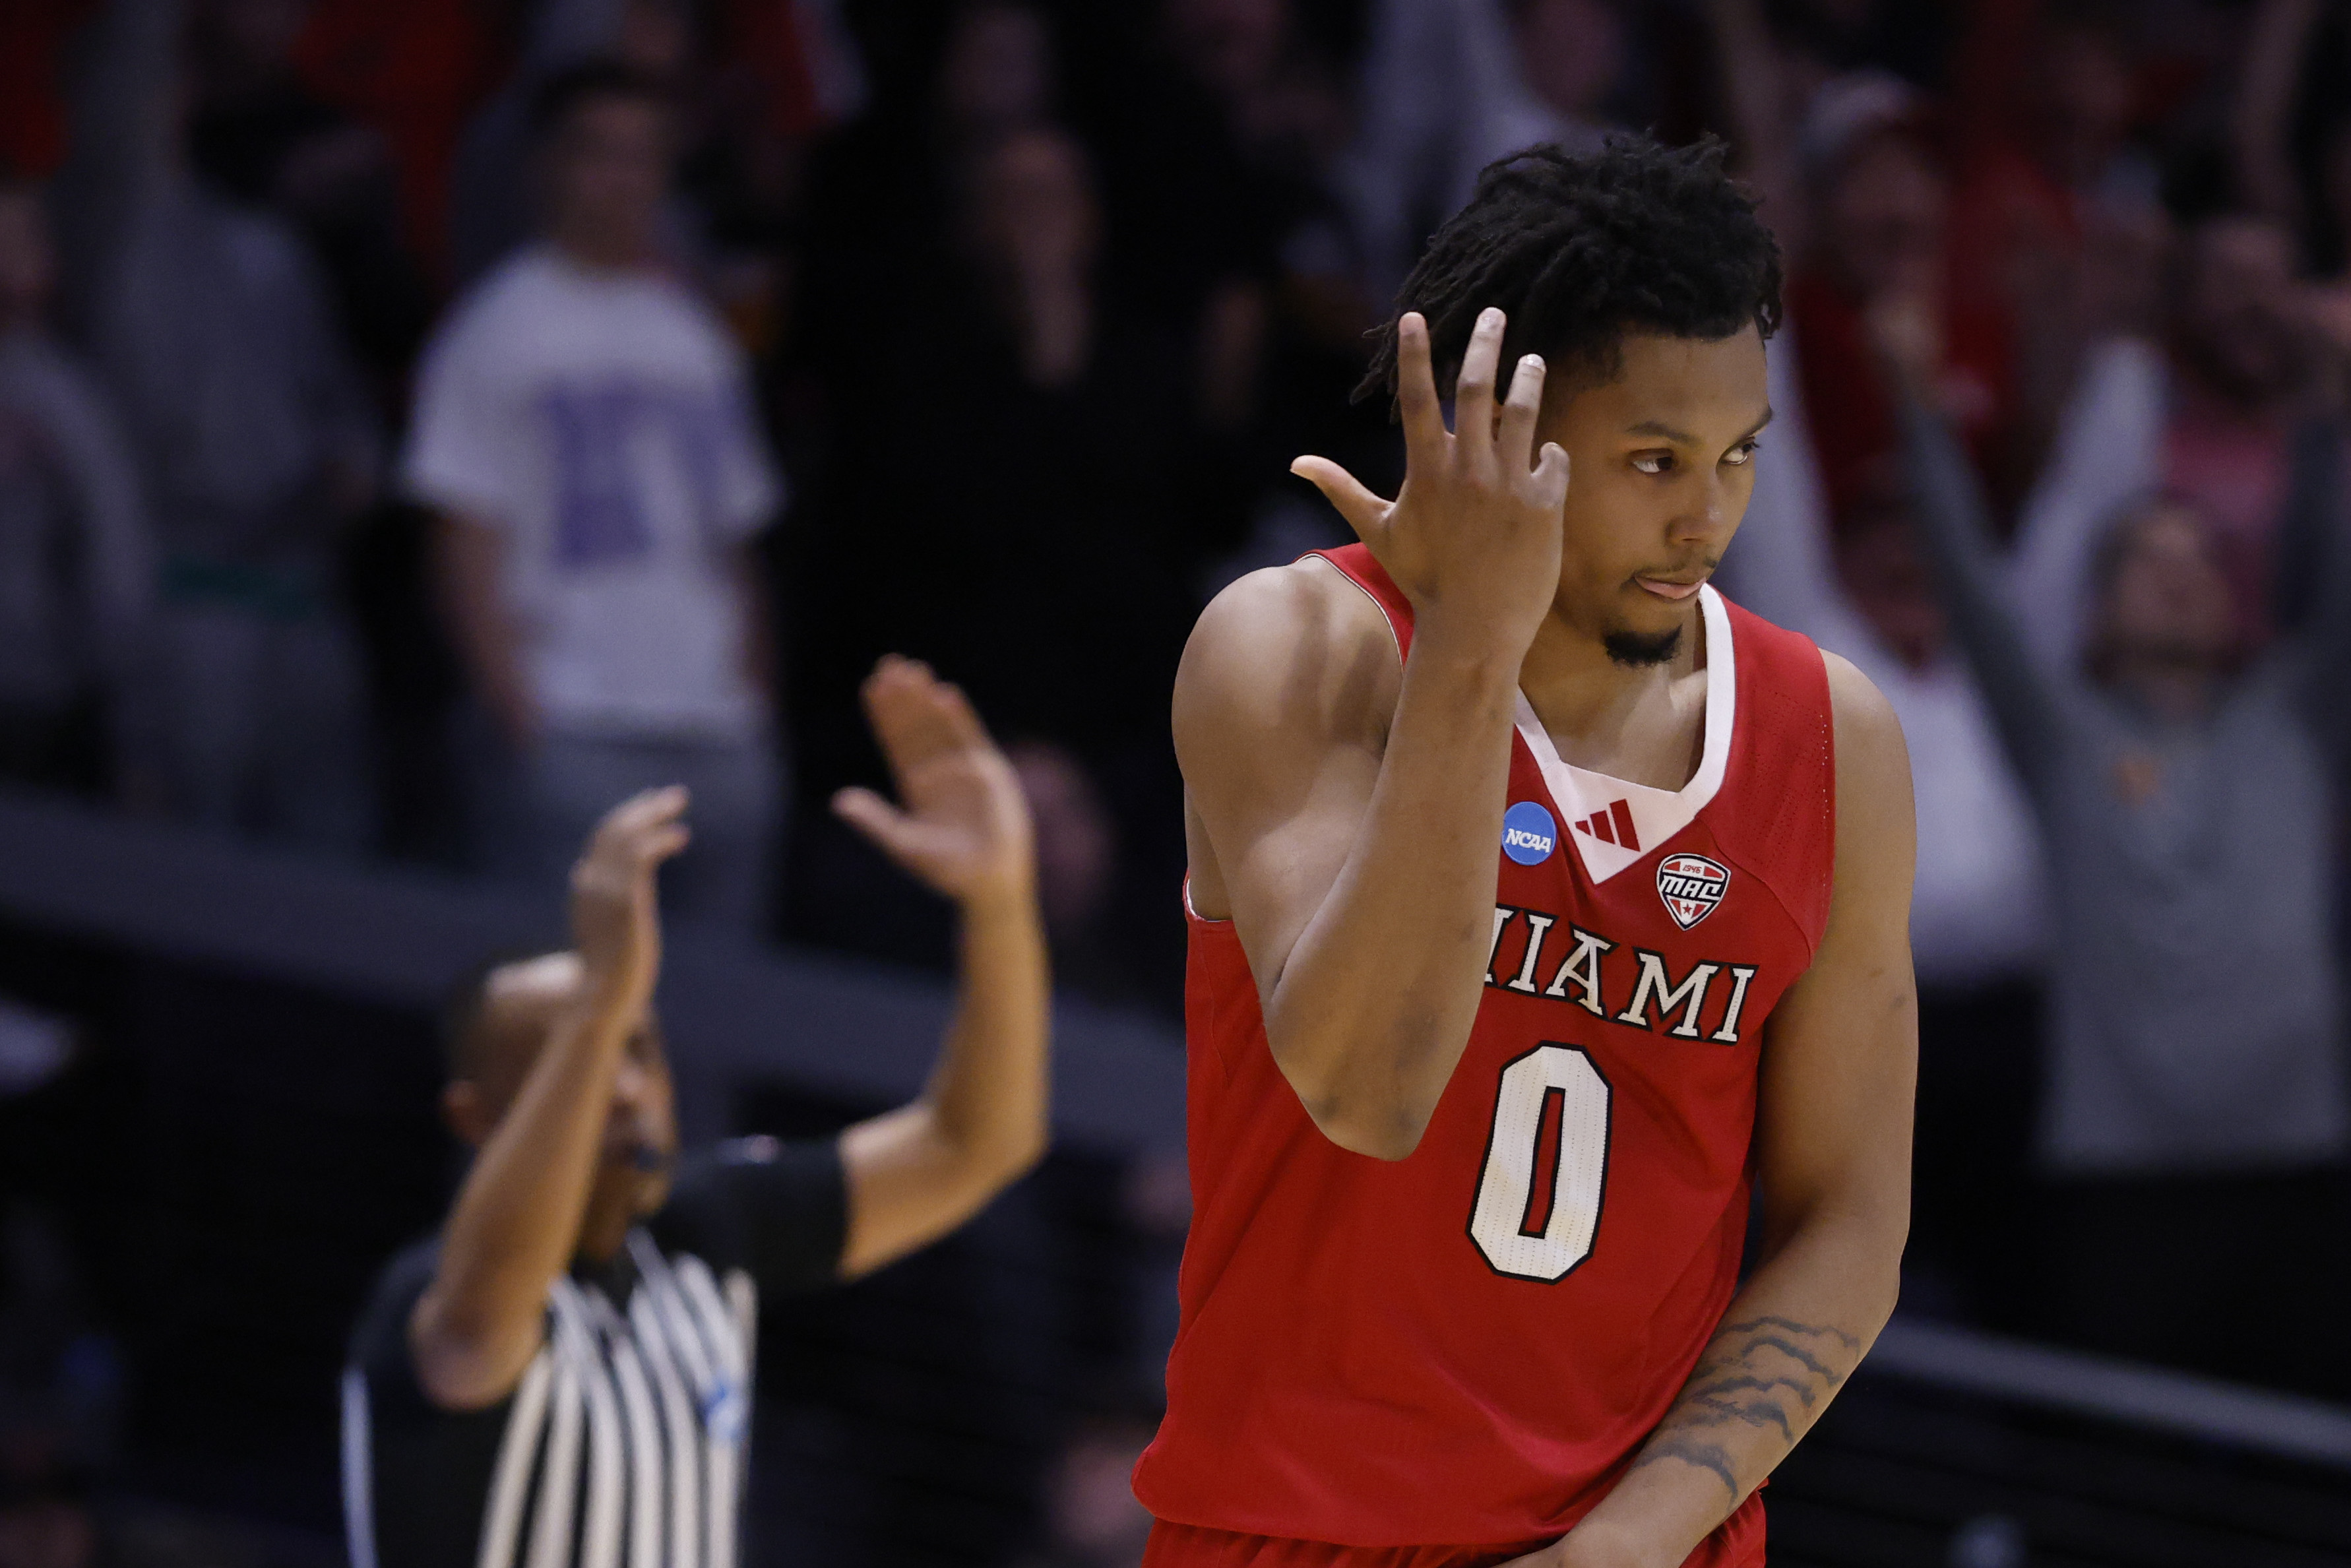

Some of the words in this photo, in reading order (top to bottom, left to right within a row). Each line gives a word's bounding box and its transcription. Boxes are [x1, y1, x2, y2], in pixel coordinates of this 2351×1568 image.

[1505, 828, 1552, 853] NCAA
[1659, 875, 1721, 901] MAC
[1465, 1040, 1614, 1285] 0
